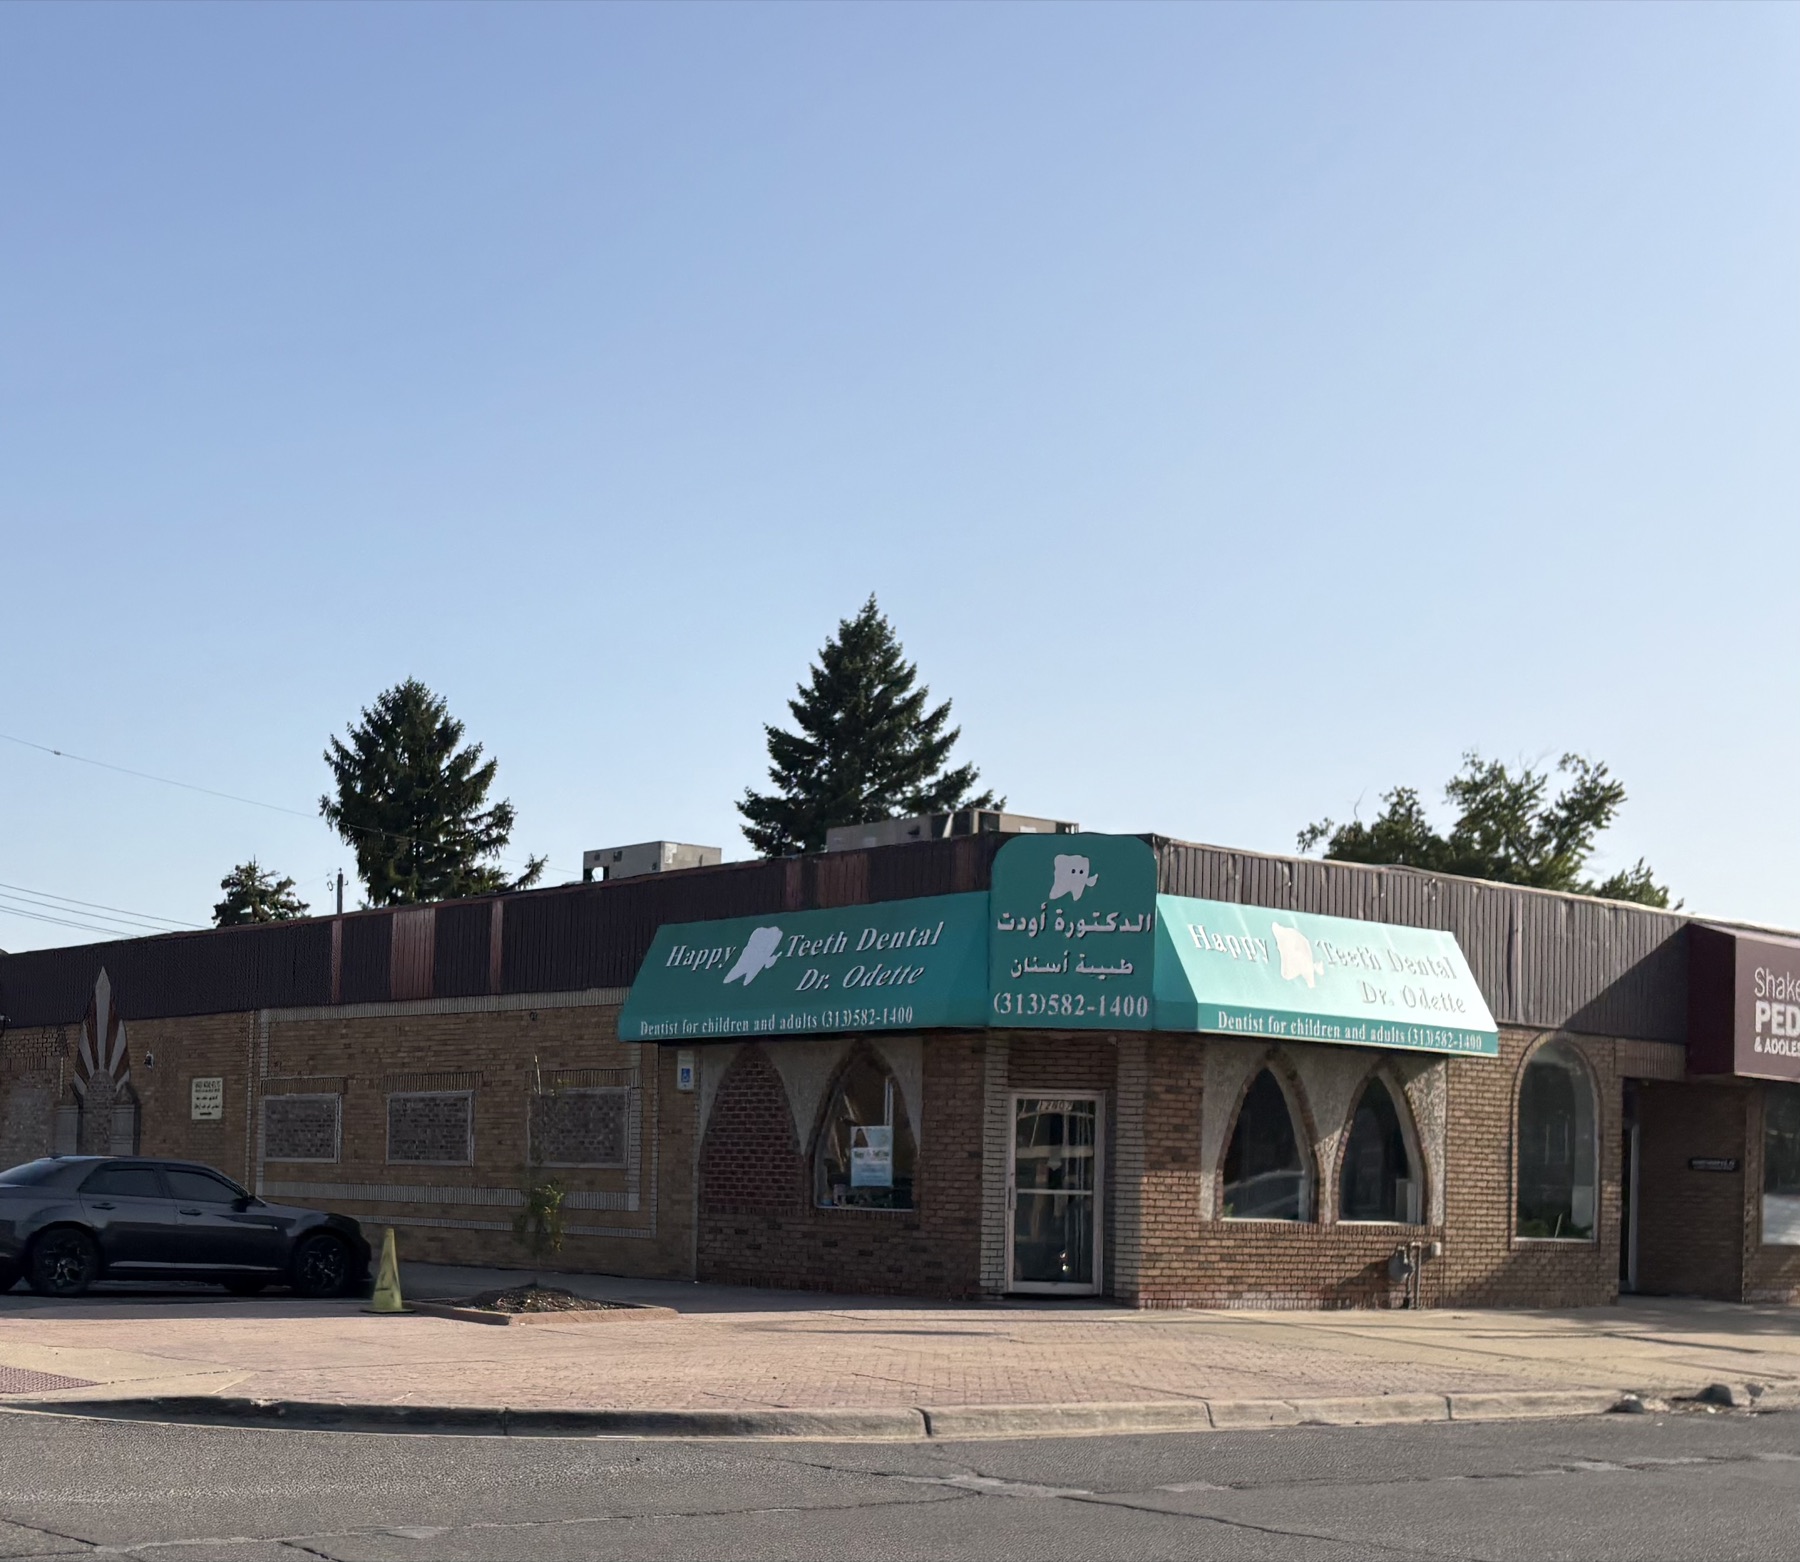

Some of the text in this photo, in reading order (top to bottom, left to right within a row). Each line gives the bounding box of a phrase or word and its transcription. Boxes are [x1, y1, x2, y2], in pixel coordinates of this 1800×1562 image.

[997, 902, 1152, 938] الدكتورة أودت
[665, 921, 945, 972] Happy Teeth Dental
[1187, 923, 1458, 980] Happy Teeth Dental
[795, 963, 925, 992] Dr. Odette
[1010, 950, 1070, 979] أسنان
[993, 992, 1149, 1018] (313)582-1400
[1361, 980, 1467, 1014] Dr. Odette
[640, 1006, 914, 1036] Dentist for children and adults (313)582-1400
[1218, 1010, 1483, 1051] Dentist for children and adults (313)582-1400
[1755, 1000, 1800, 1038] PED
[1754, 1035, 1763, 1053] &
